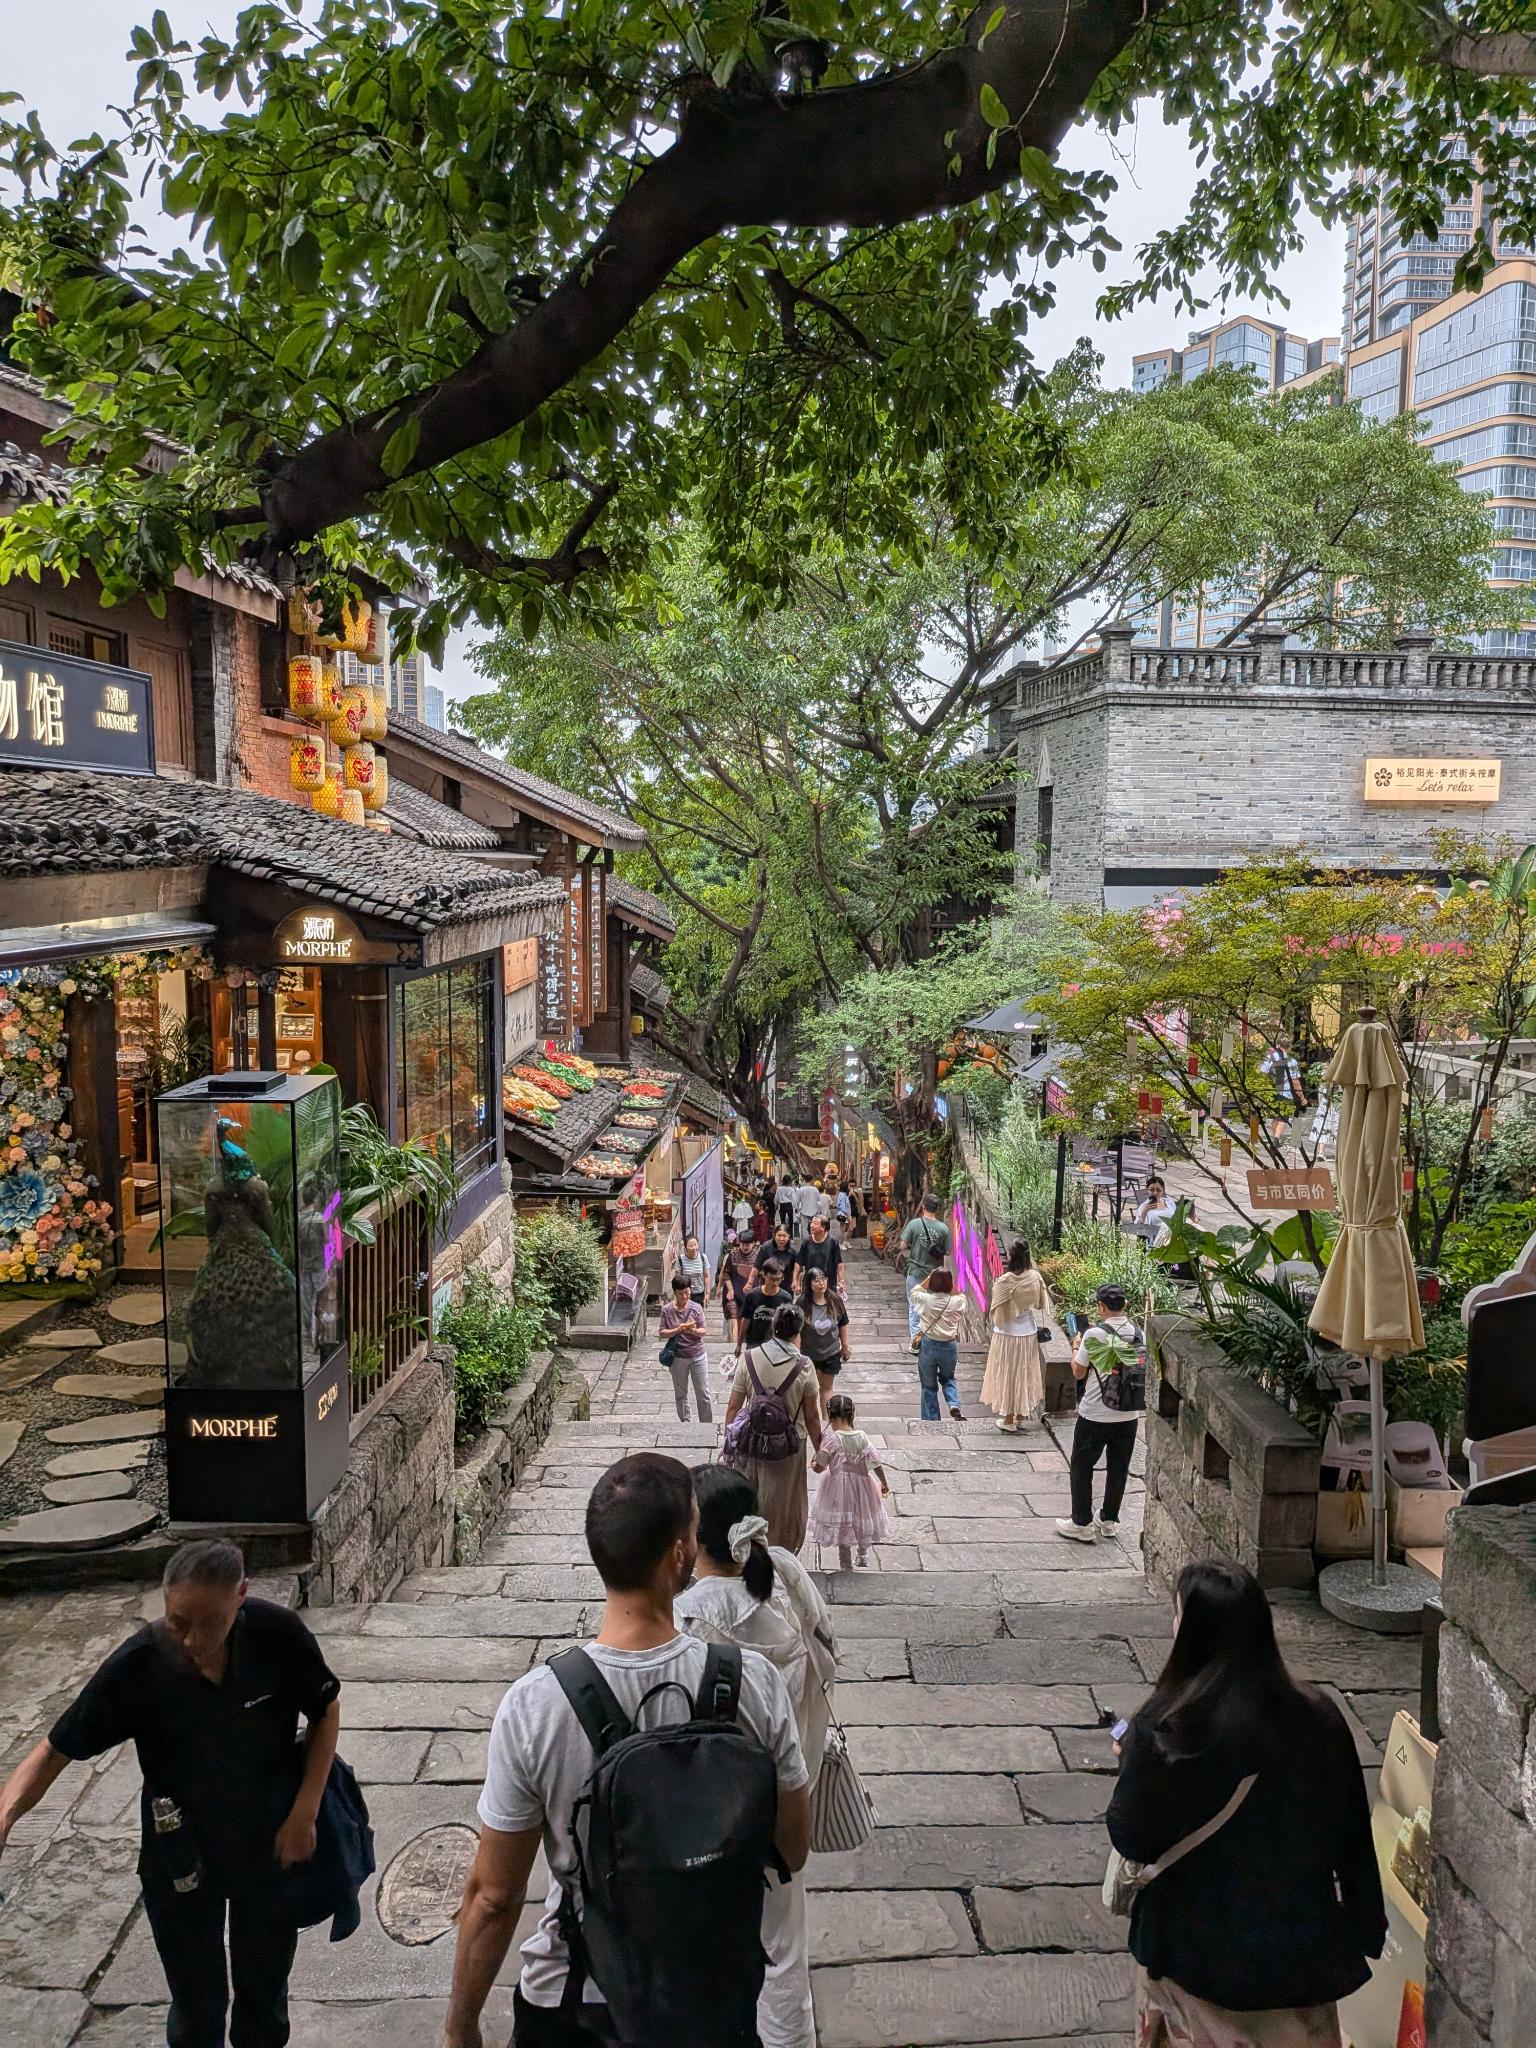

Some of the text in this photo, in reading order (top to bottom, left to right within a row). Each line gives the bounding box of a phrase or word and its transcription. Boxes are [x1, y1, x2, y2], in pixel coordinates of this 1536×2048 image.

[1416, 779, 1475, 792] Let's relax
[1256, 1183, 1326, 1200] 与市区同价
